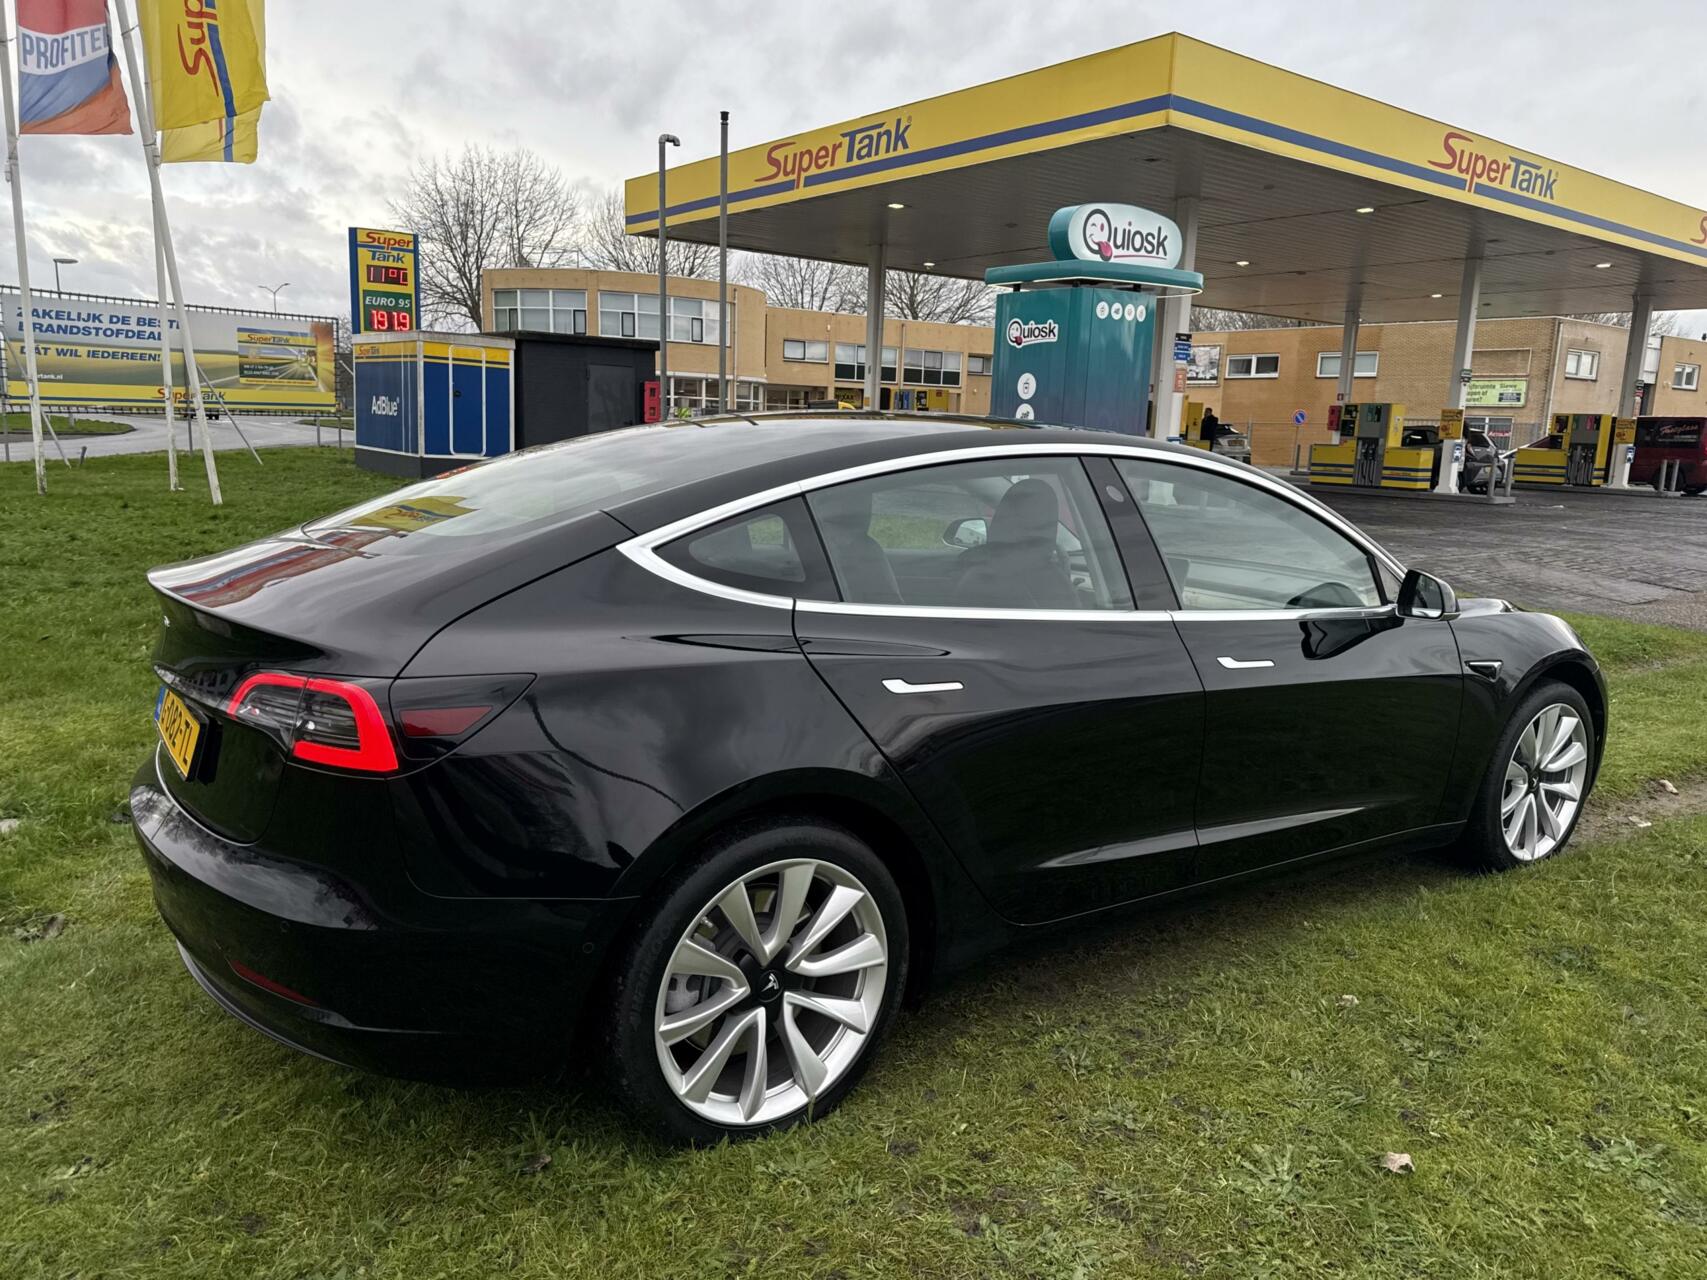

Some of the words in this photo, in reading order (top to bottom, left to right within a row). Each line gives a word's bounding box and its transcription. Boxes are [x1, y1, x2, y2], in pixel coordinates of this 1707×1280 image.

[754, 118, 912, 189] SuperTank
[1427, 131, 1558, 200] SuperTank
[359, 231, 413, 253] Super
[1083, 208, 1168, 262] Quiosk
[367, 249, 406, 264] Tank
[365, 296, 396, 307] EURO
[398, 299, 411, 308] 95
[108, 314, 131, 326] DE
[136, 316, 180, 330] BET
[1008, 320, 1056, 346] Quiosk
[55, 347, 82, 358] WIL
[371, 395, 399, 416] AdBlue
